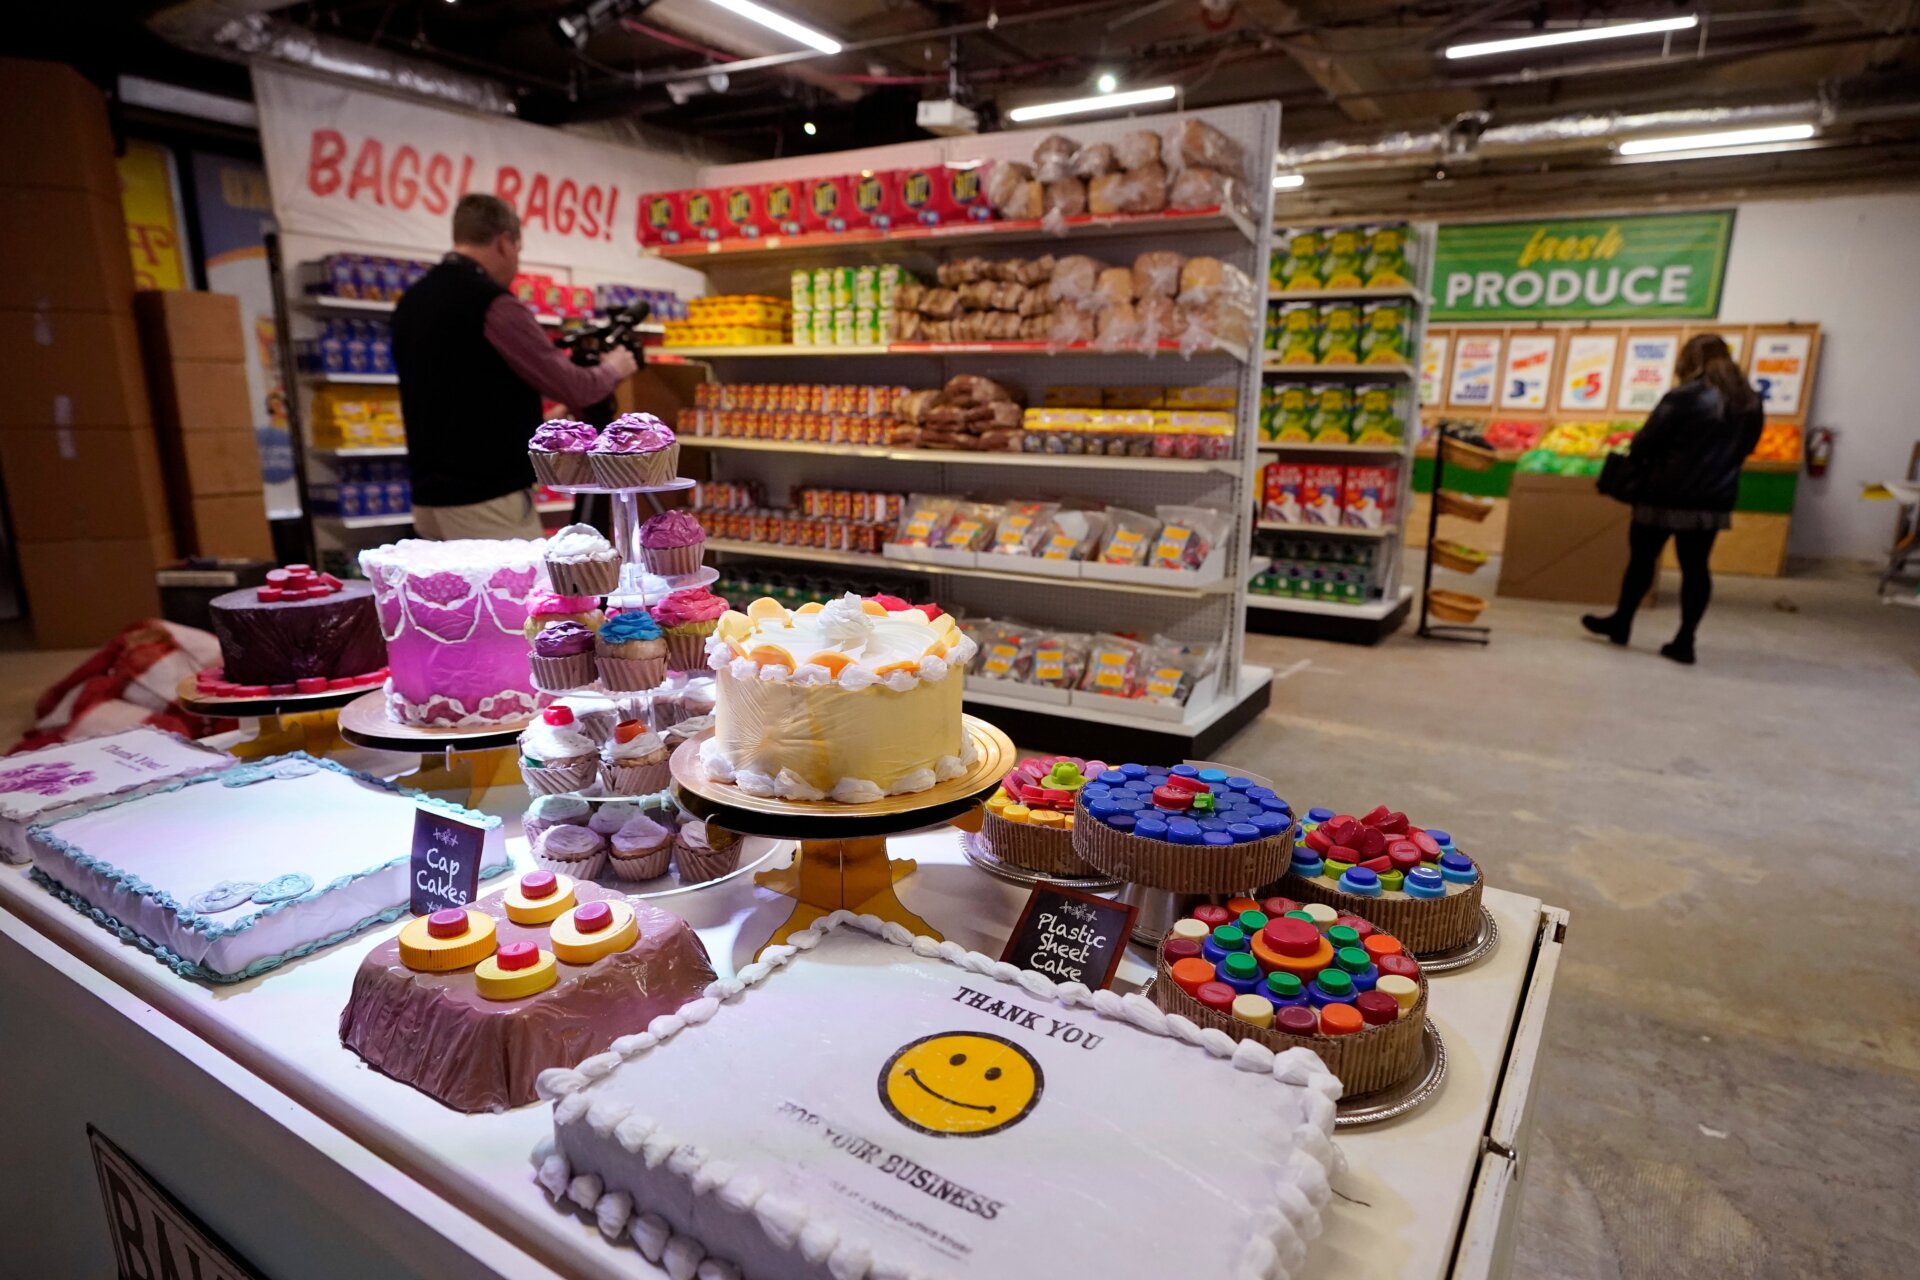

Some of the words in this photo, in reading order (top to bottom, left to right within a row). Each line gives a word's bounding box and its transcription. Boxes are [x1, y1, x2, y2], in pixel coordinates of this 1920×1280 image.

[306, 127, 475, 217] BAGS!
[495, 165, 619, 242] BAGS!
[1517, 224, 1623, 268] fresh
[1445, 265, 1692, 307] PRODUCE
[416, 869, 467, 906] Cakes
[426, 848, 460, 888] Cap
[1037, 913, 1107, 949] Plastic
[1038, 932, 1090, 964] Sheet
[1030, 952, 1082, 983] Cake
[952, 985, 1045, 1031] THANK
[1045, 1019, 1104, 1050] YOU
[877, 1154, 1006, 1220] BUSINESS
